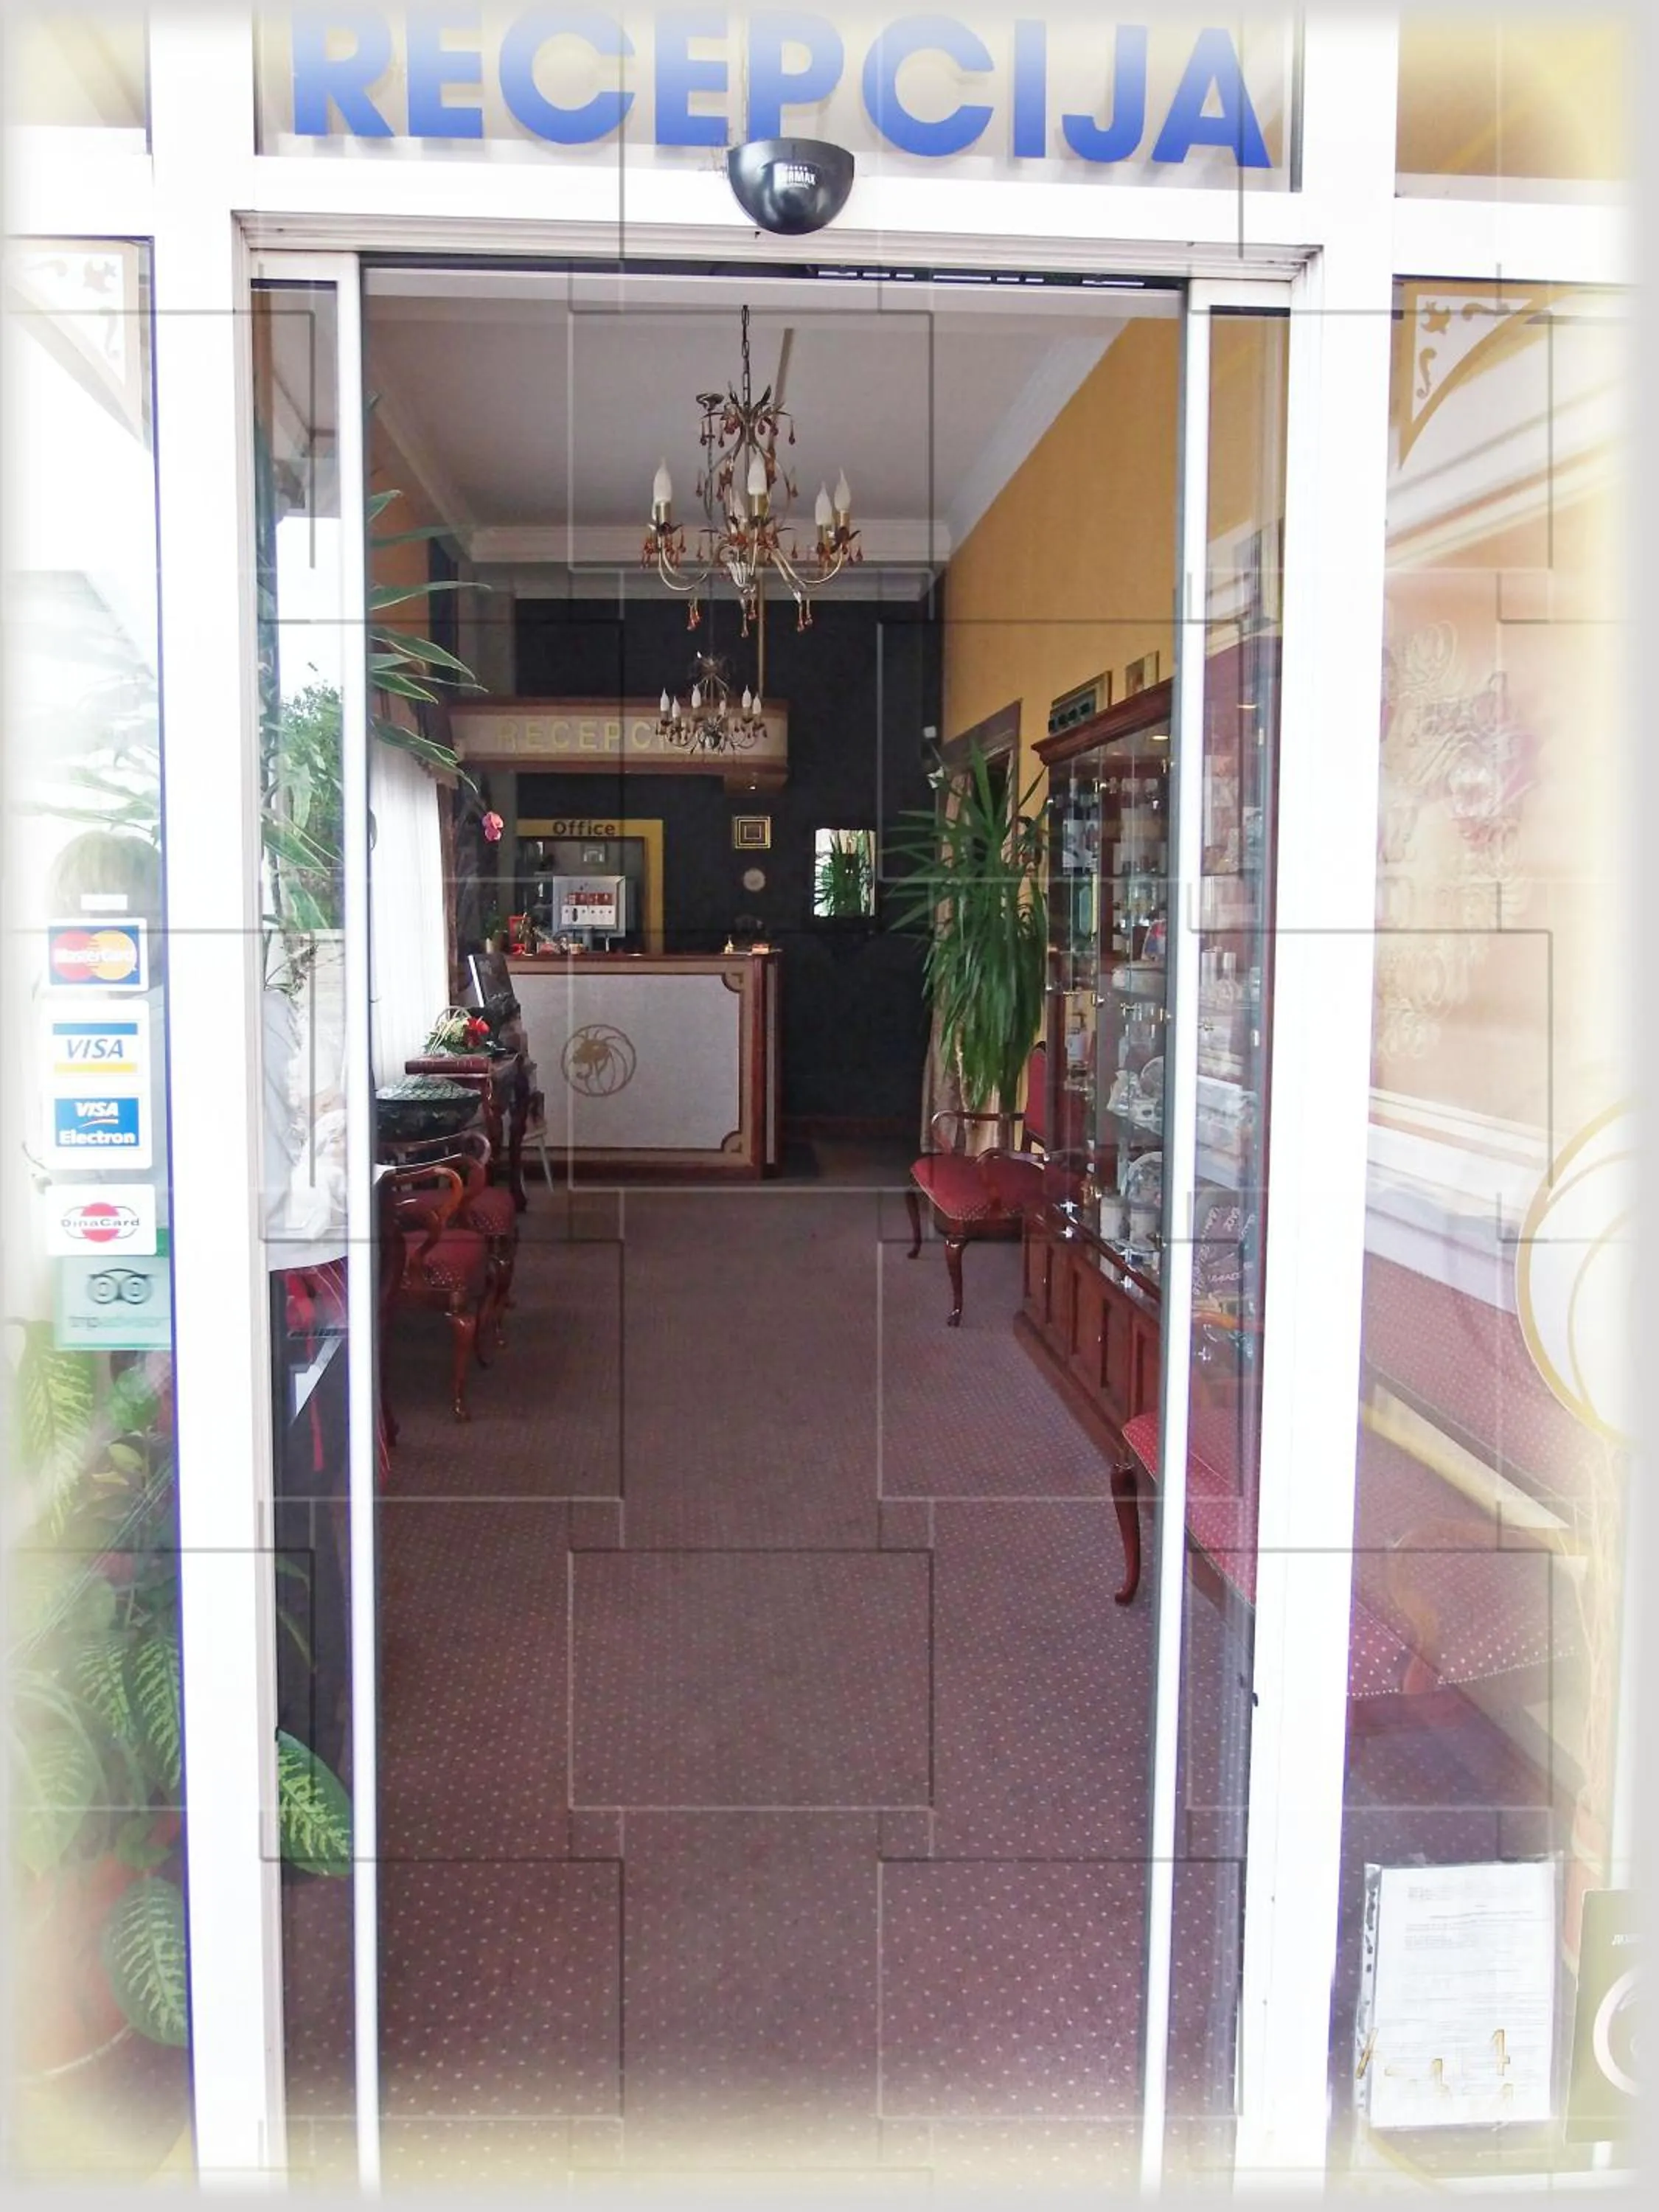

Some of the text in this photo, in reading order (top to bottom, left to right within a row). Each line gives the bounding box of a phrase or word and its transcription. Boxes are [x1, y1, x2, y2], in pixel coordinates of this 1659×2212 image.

[293, 2, 1270, 170] RECEPCIJA
[497, 717, 672, 751] RECEPC
[552, 821, 616, 837] Office
[67, 1038, 124, 1059] VISA
[74, 1102, 119, 1118] VISA
[59, 1130, 136, 1144] Electron
[60, 1217, 140, 1228] DinaCard
